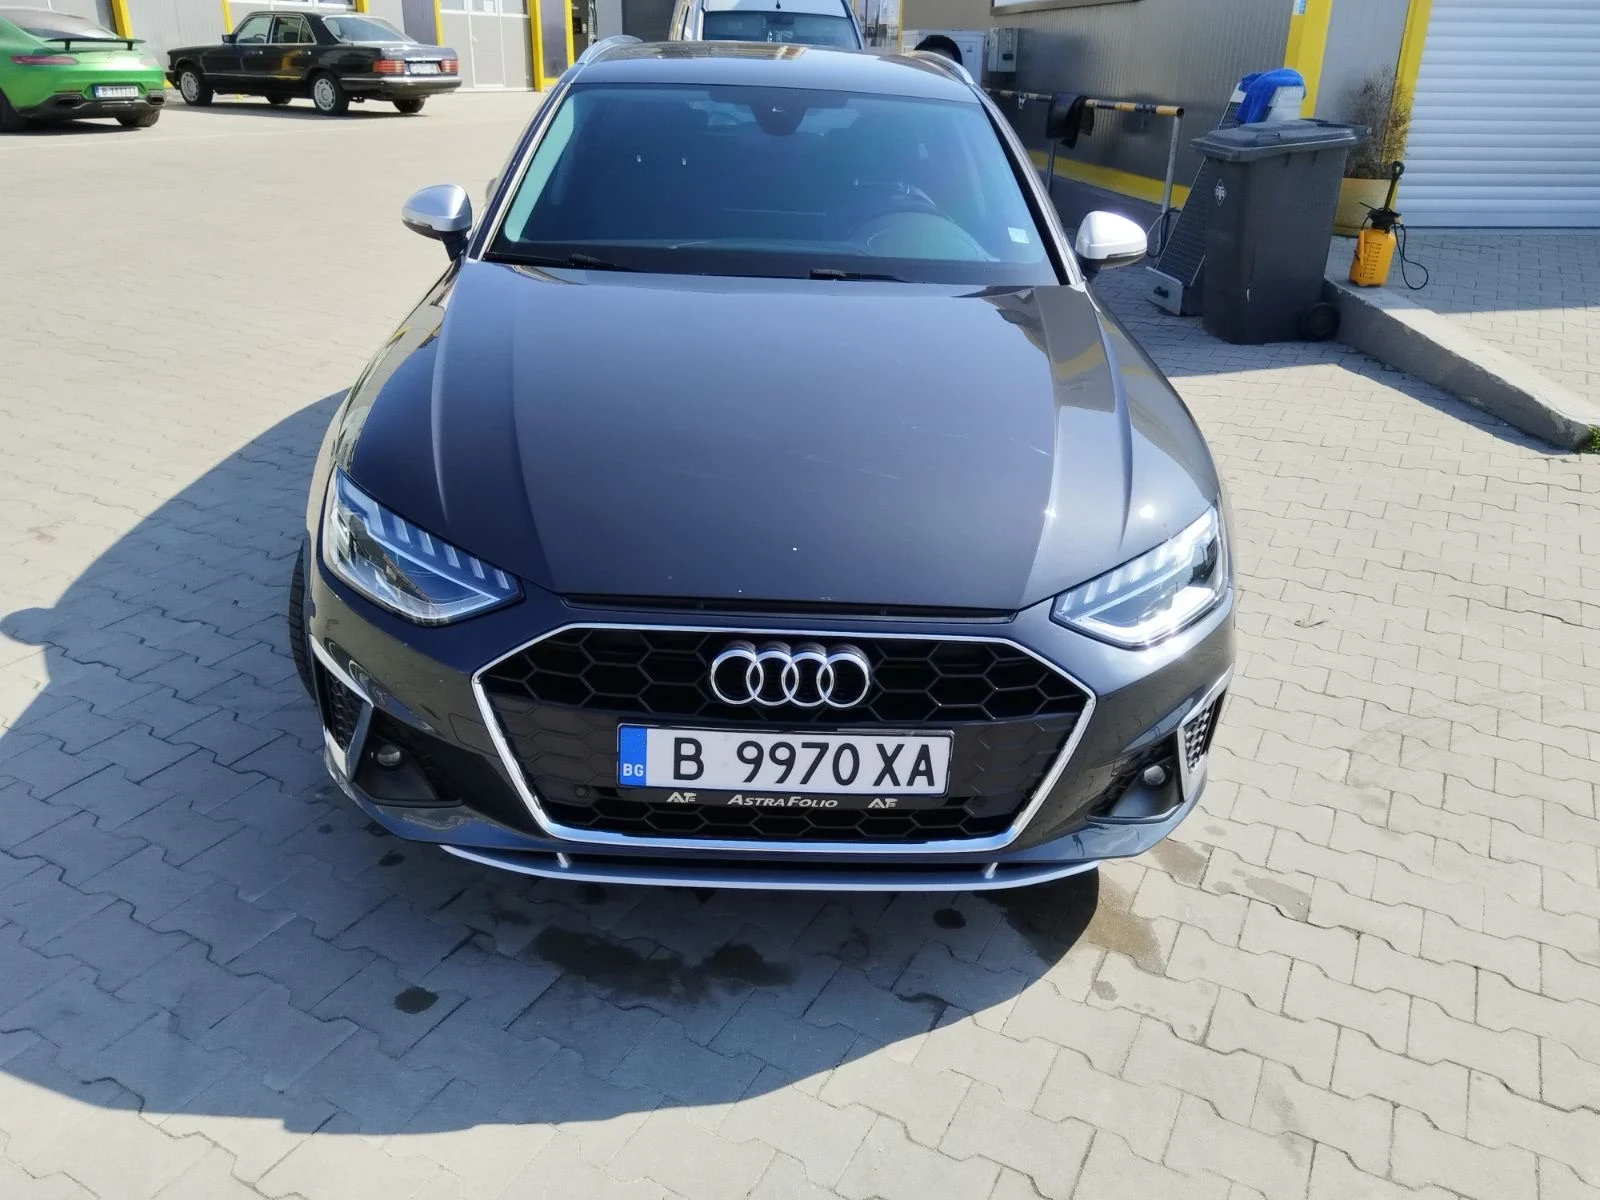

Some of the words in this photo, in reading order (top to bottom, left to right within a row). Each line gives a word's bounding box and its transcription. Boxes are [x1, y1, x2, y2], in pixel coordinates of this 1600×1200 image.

[623, 763, 644, 777] BG
[673, 737, 704, 780] B
[736, 740, 860, 786] 9970
[872, 743, 935, 786] XA
